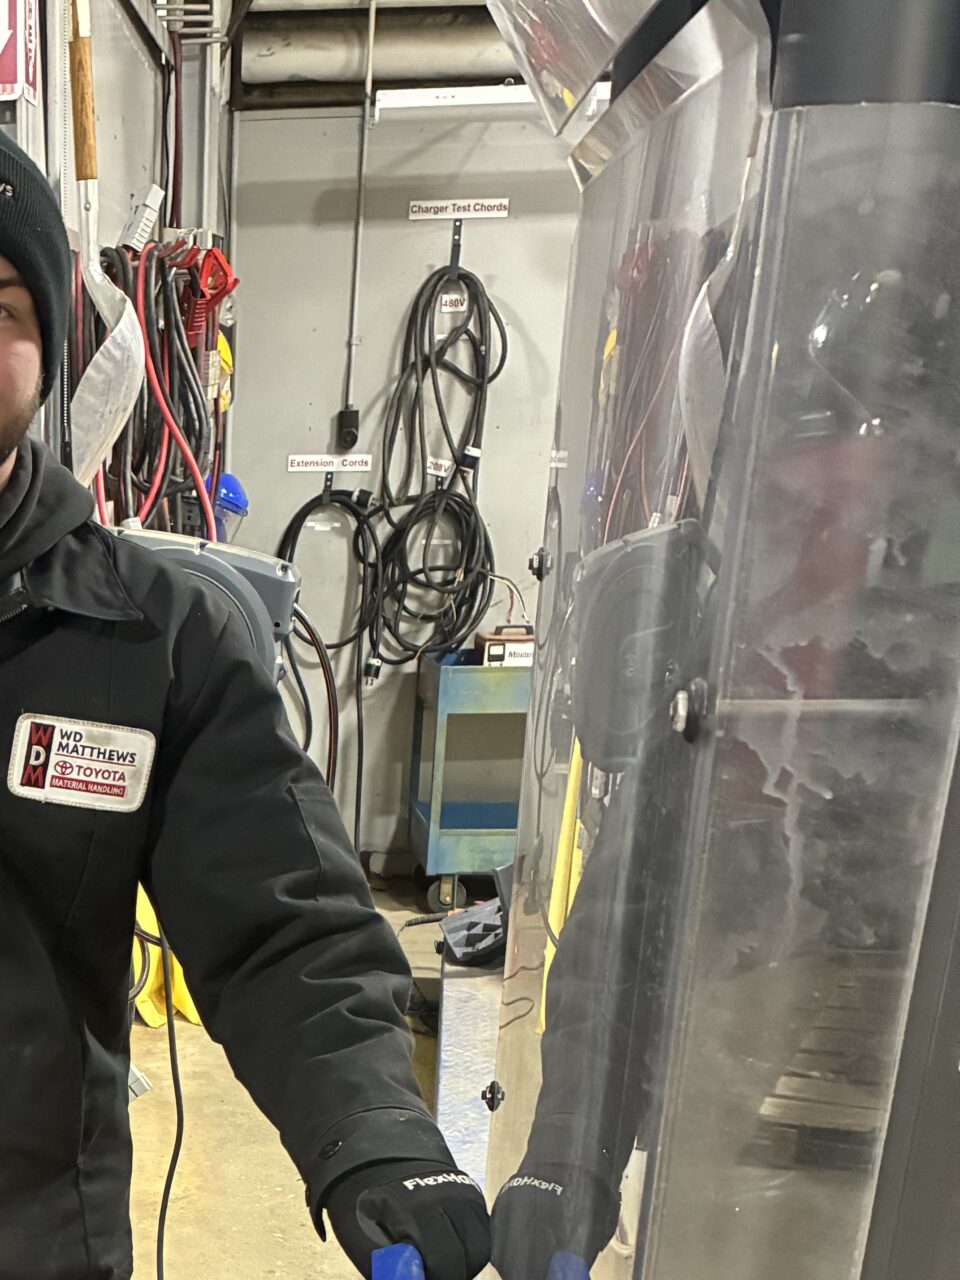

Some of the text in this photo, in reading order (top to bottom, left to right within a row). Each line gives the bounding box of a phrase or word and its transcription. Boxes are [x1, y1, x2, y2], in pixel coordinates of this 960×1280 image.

[410, 202, 508, 216] Charger Test Chords
[290, 458, 369, 468] Extension Cords
[60, 729, 83, 743] WD
[56, 741, 137, 763] MATTHEWS
[75, 765, 126, 782] TOYOTA
[51, 777, 124, 795] MATERIAL HANDLING
